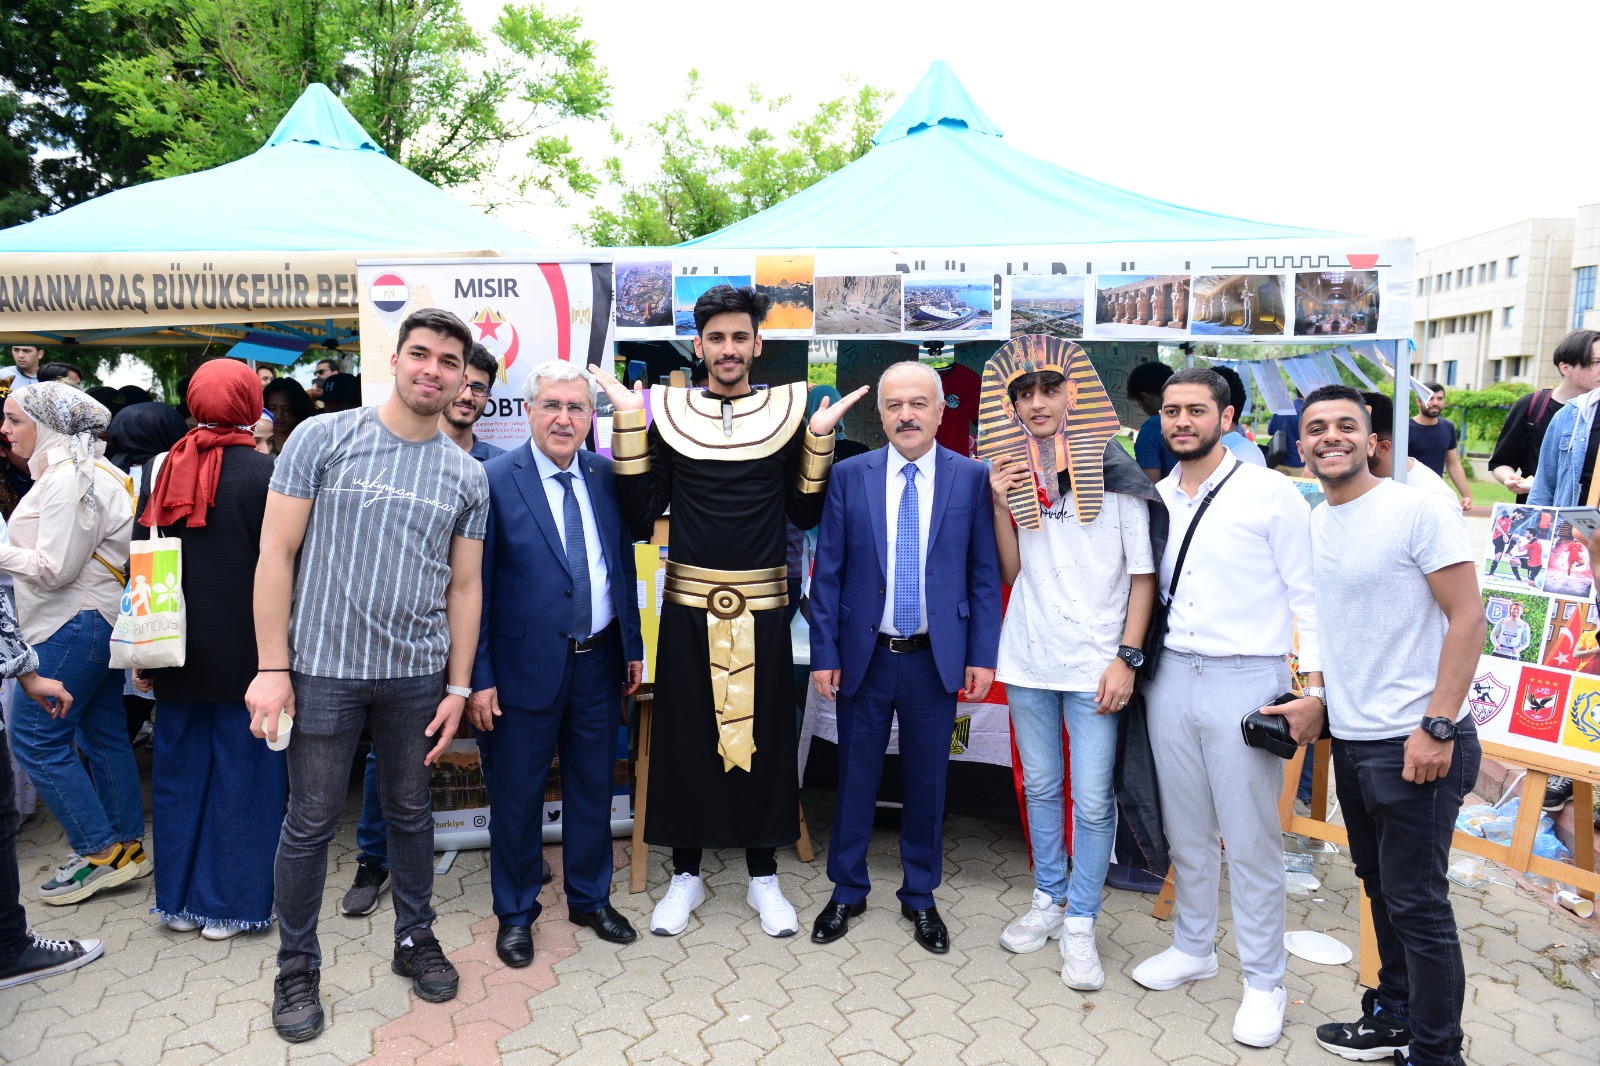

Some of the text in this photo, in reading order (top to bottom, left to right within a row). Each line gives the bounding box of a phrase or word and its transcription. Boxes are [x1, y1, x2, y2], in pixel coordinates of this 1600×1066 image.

[153, 262, 309, 312] BÜYÜKŞEHİR
[454, 278, 520, 298] MISIR
[434, 819, 465, 829] turkiye
